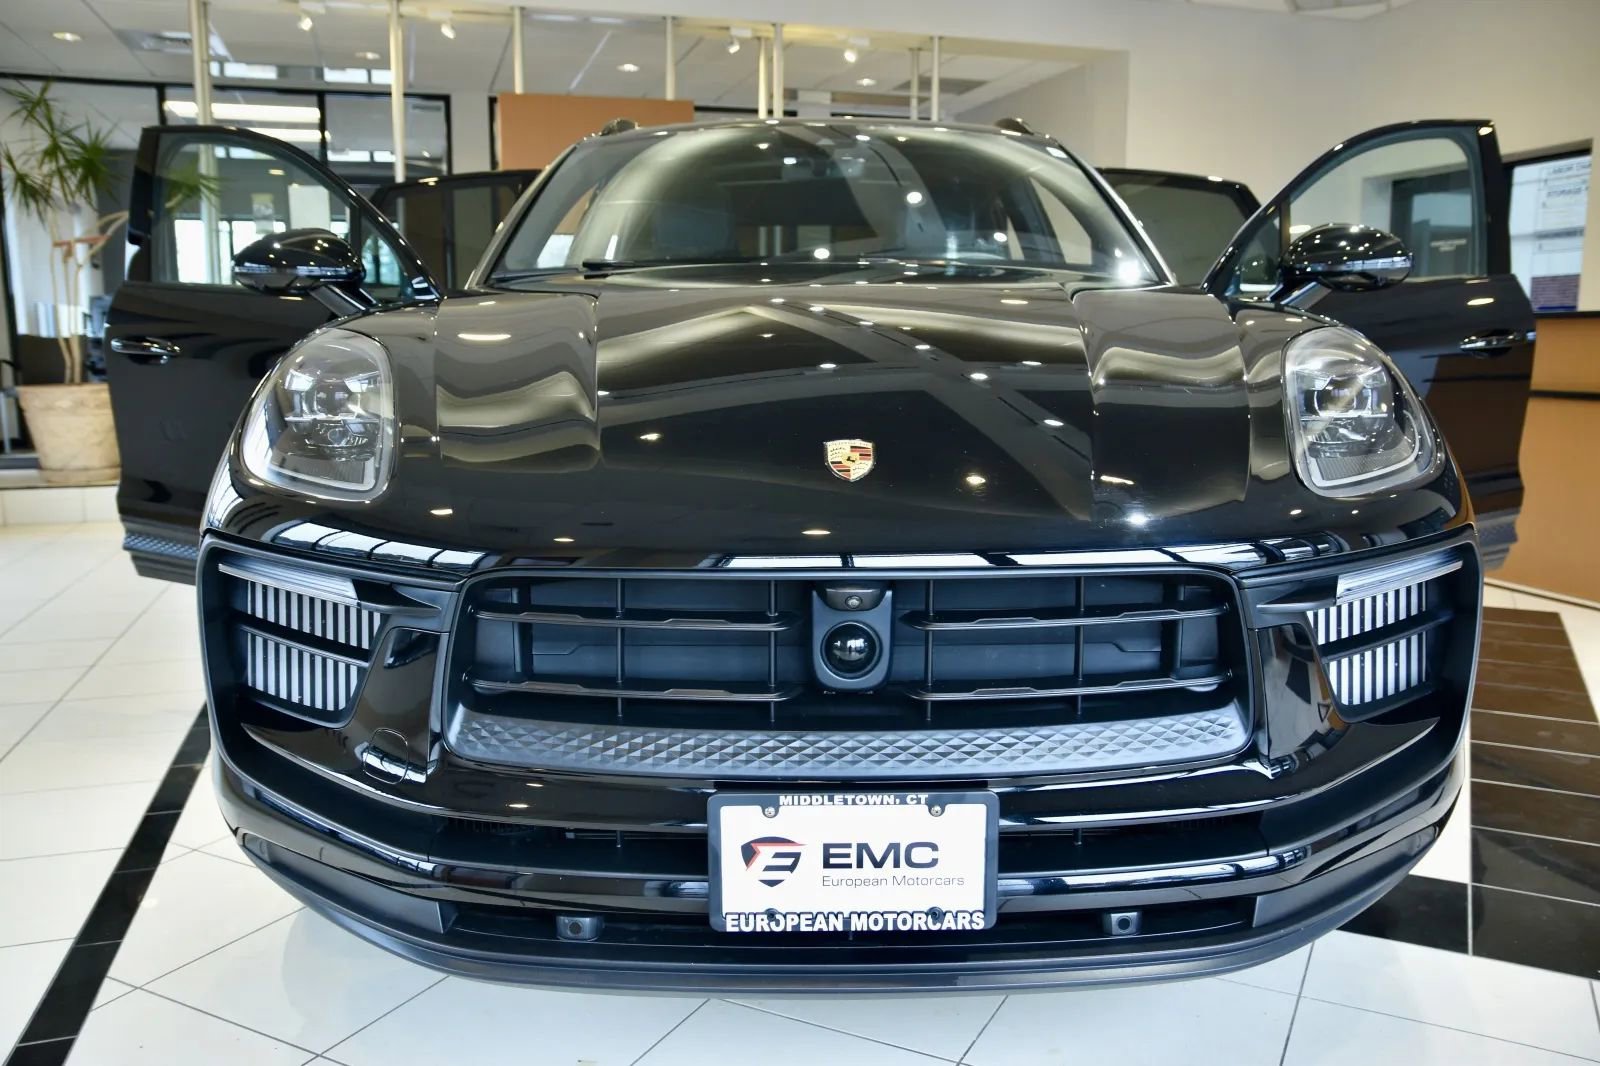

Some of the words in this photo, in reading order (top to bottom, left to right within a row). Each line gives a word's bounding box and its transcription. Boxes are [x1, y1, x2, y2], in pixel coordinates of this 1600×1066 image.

[779, 794, 901, 806] MIDDLETOWN,
[906, 793, 929, 805] CT
[822, 841, 939, 869] EMC
[822, 875, 888, 888] European
[892, 875, 965, 887] Motorcars
[725, 913, 844, 932] EUROPEAN
[850, 912, 985, 931] MOTORCARS
